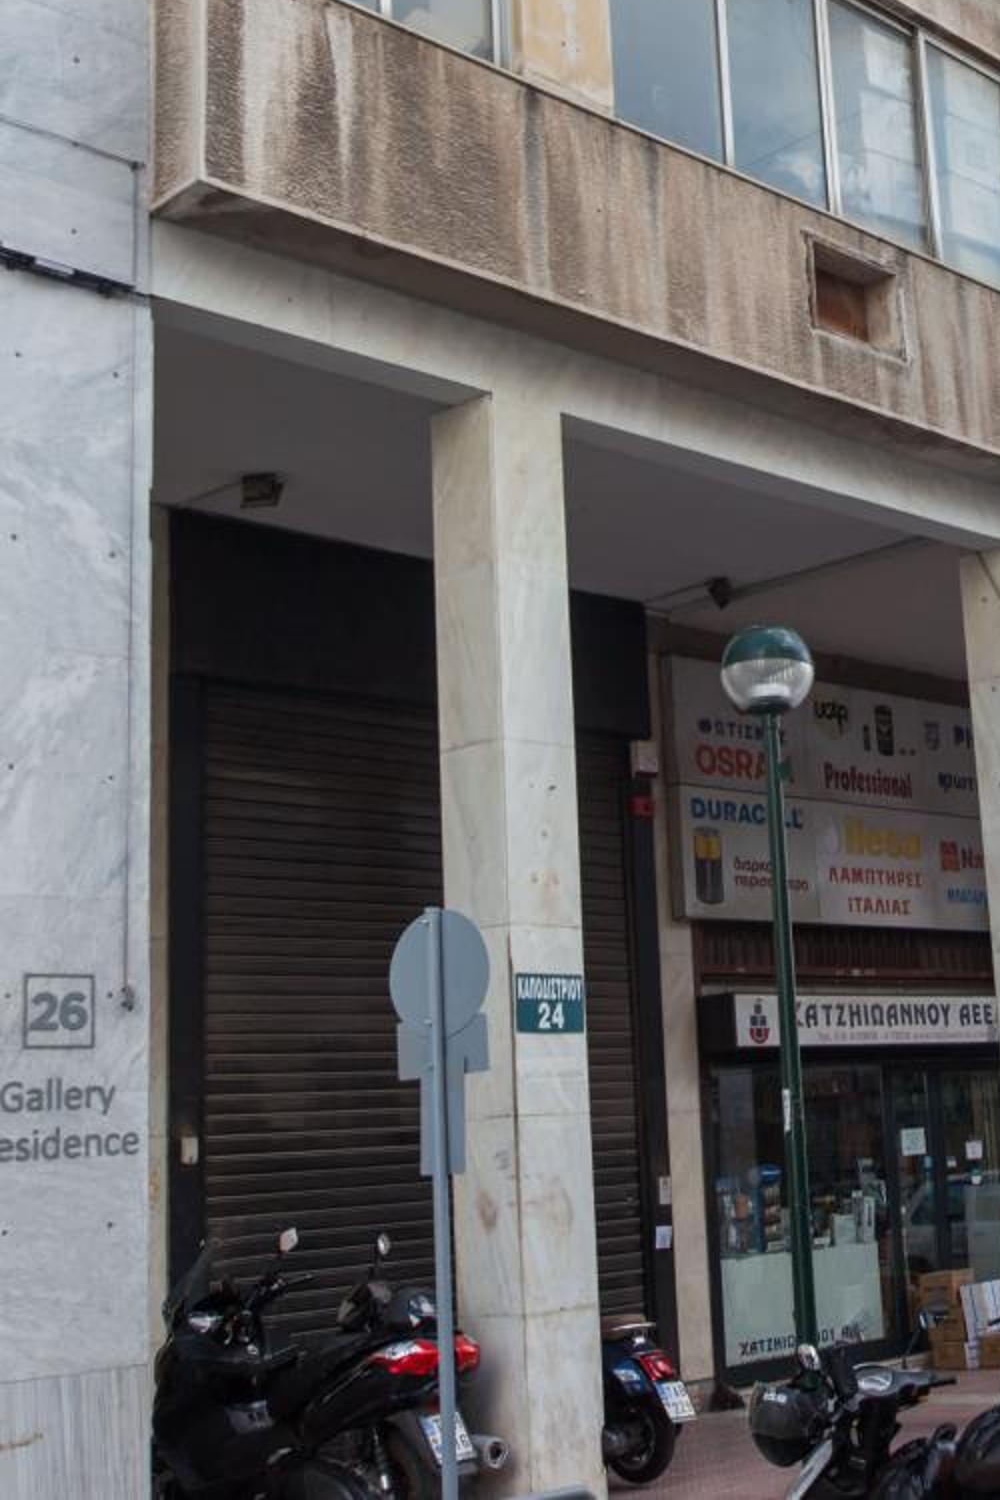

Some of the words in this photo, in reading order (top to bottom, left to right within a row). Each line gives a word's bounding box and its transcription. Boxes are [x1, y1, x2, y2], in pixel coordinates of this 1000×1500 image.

[823, 761, 913, 800] Professional
[847, 896, 912, 917] ΙΤΑΛΙΑΣ
[29, 991, 88, 1032] 26
[538, 1001, 565, 1029] 24
[0, 1078, 116, 1117] Gallery
